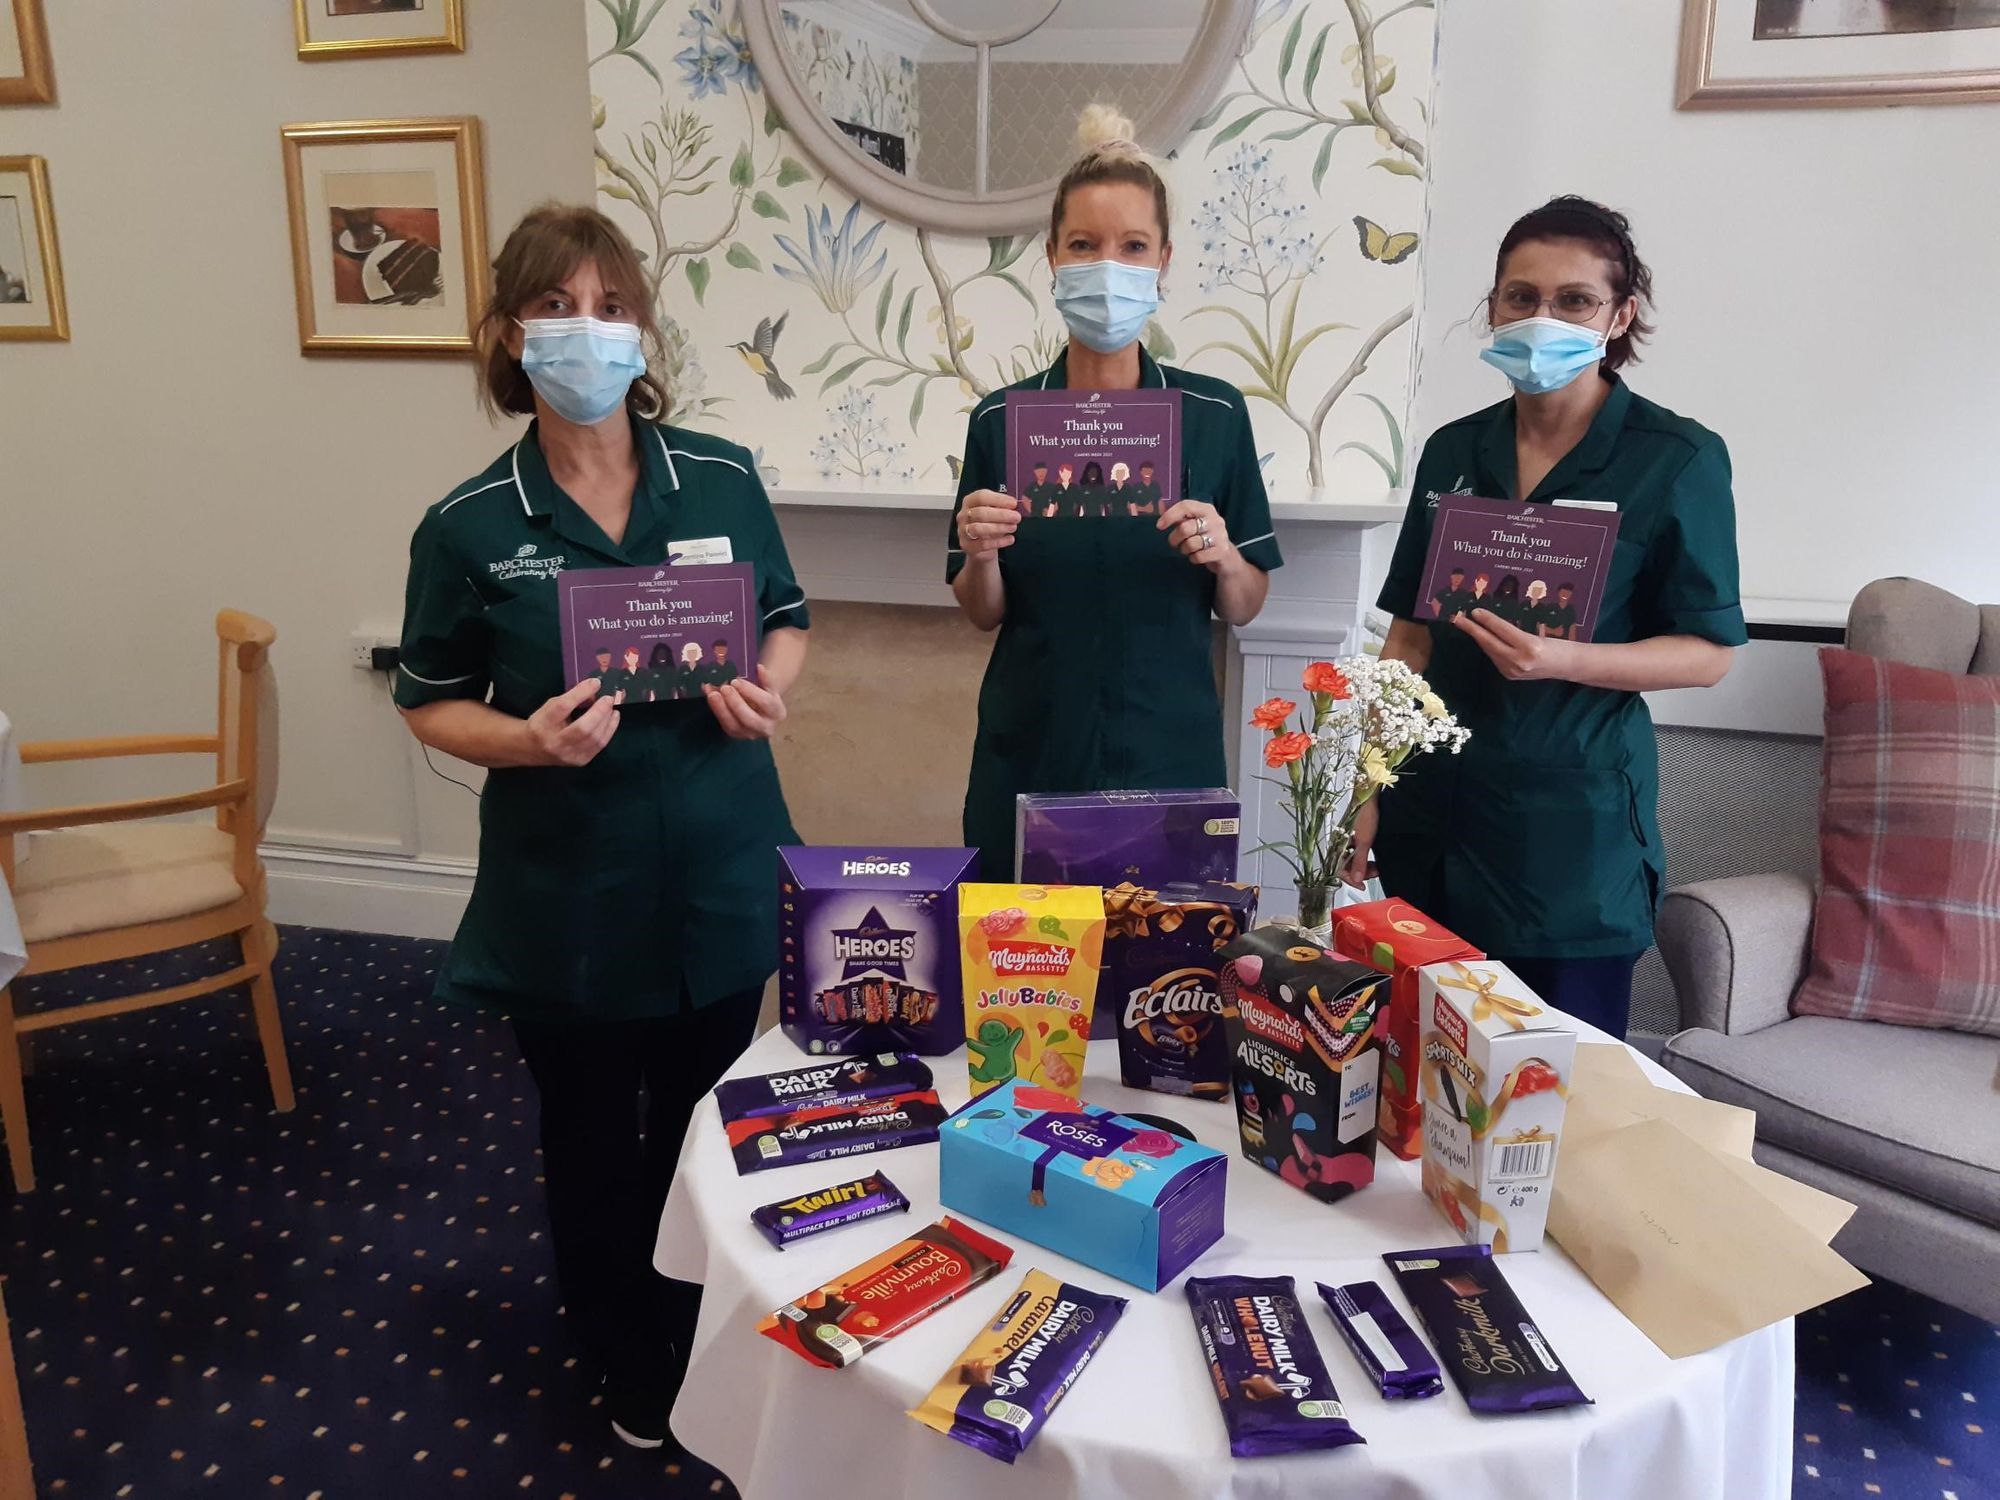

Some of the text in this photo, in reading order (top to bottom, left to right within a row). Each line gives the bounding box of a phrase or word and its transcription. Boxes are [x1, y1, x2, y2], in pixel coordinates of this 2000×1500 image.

[1063, 419, 1123, 434] Thank you
[1029, 433, 1161, 449] What you do is amazing!
[1491, 529, 1551, 548] Thank you
[489, 555, 566, 573] BARCHESTER
[1453, 540, 1588, 570] What you do is amazing!
[498, 568, 548, 580] Celebrating
[625, 598, 693, 613] Thank you
[588, 610, 734, 631] What you do is amazing!
[842, 860, 912, 878] HEROES
[834, 935, 916, 960] HEROES
[988, 945, 1071, 972] Maynards
[1026, 965, 1066, 973] BASSETTS
[1123, 985, 1224, 1030] Eclairs
[1237, 998, 1305, 1043] Maynards
[1435, 1007, 1466, 1049] Bassetts
[1267, 1028, 1301, 1049] BASSETTS
[1247, 1038, 1297, 1069] LIQUORICE
[769, 1066, 842, 1090] DAIRY
[1236, 1040, 1317, 1097] ALLSORTS
[773, 1079, 836, 1097] MILK
[822, 1097, 848, 1108] DAIRY
[847, 1093, 867, 1105] MILK
[808, 1110, 909, 1135] DAIRY MILK
[1046, 1120, 1107, 1148] ROSES
[829, 1145, 851, 1158] MILK
[849, 1141, 876, 1154] DAIRY
[778, 1182, 867, 1214] Twirl
[783, 1222, 824, 1239] MULTIPACK
[825, 1217, 841, 1228] BAR
[846, 1212, 862, 1222] NOT
[862, 1206, 877, 1216] FOR
[877, 1198, 903, 1213] RESALE
[860, 1250, 950, 1300] Bournville
[904, 1260, 962, 1292] Cadbury
[1002, 1295, 1056, 1352] Caramel
[1051, 1305, 1095, 1344] Cadbury
[1200, 1324, 1214, 1346] DAIRY
[1234, 1296, 1275, 1370] WHOLENUT
[1252, 1296, 1299, 1375] DAIRY MILK
[1008, 1300, 1078, 1373] DAIRY MILK
[1454, 1298, 1526, 1376] Darkmilk
[1073, 1350, 1091, 1374] DAIRY
[1206, 1344, 1219, 1364] MILK
[1457, 1327, 1492, 1375] Cadbury
[1062, 1368, 1080, 1389] MILK
